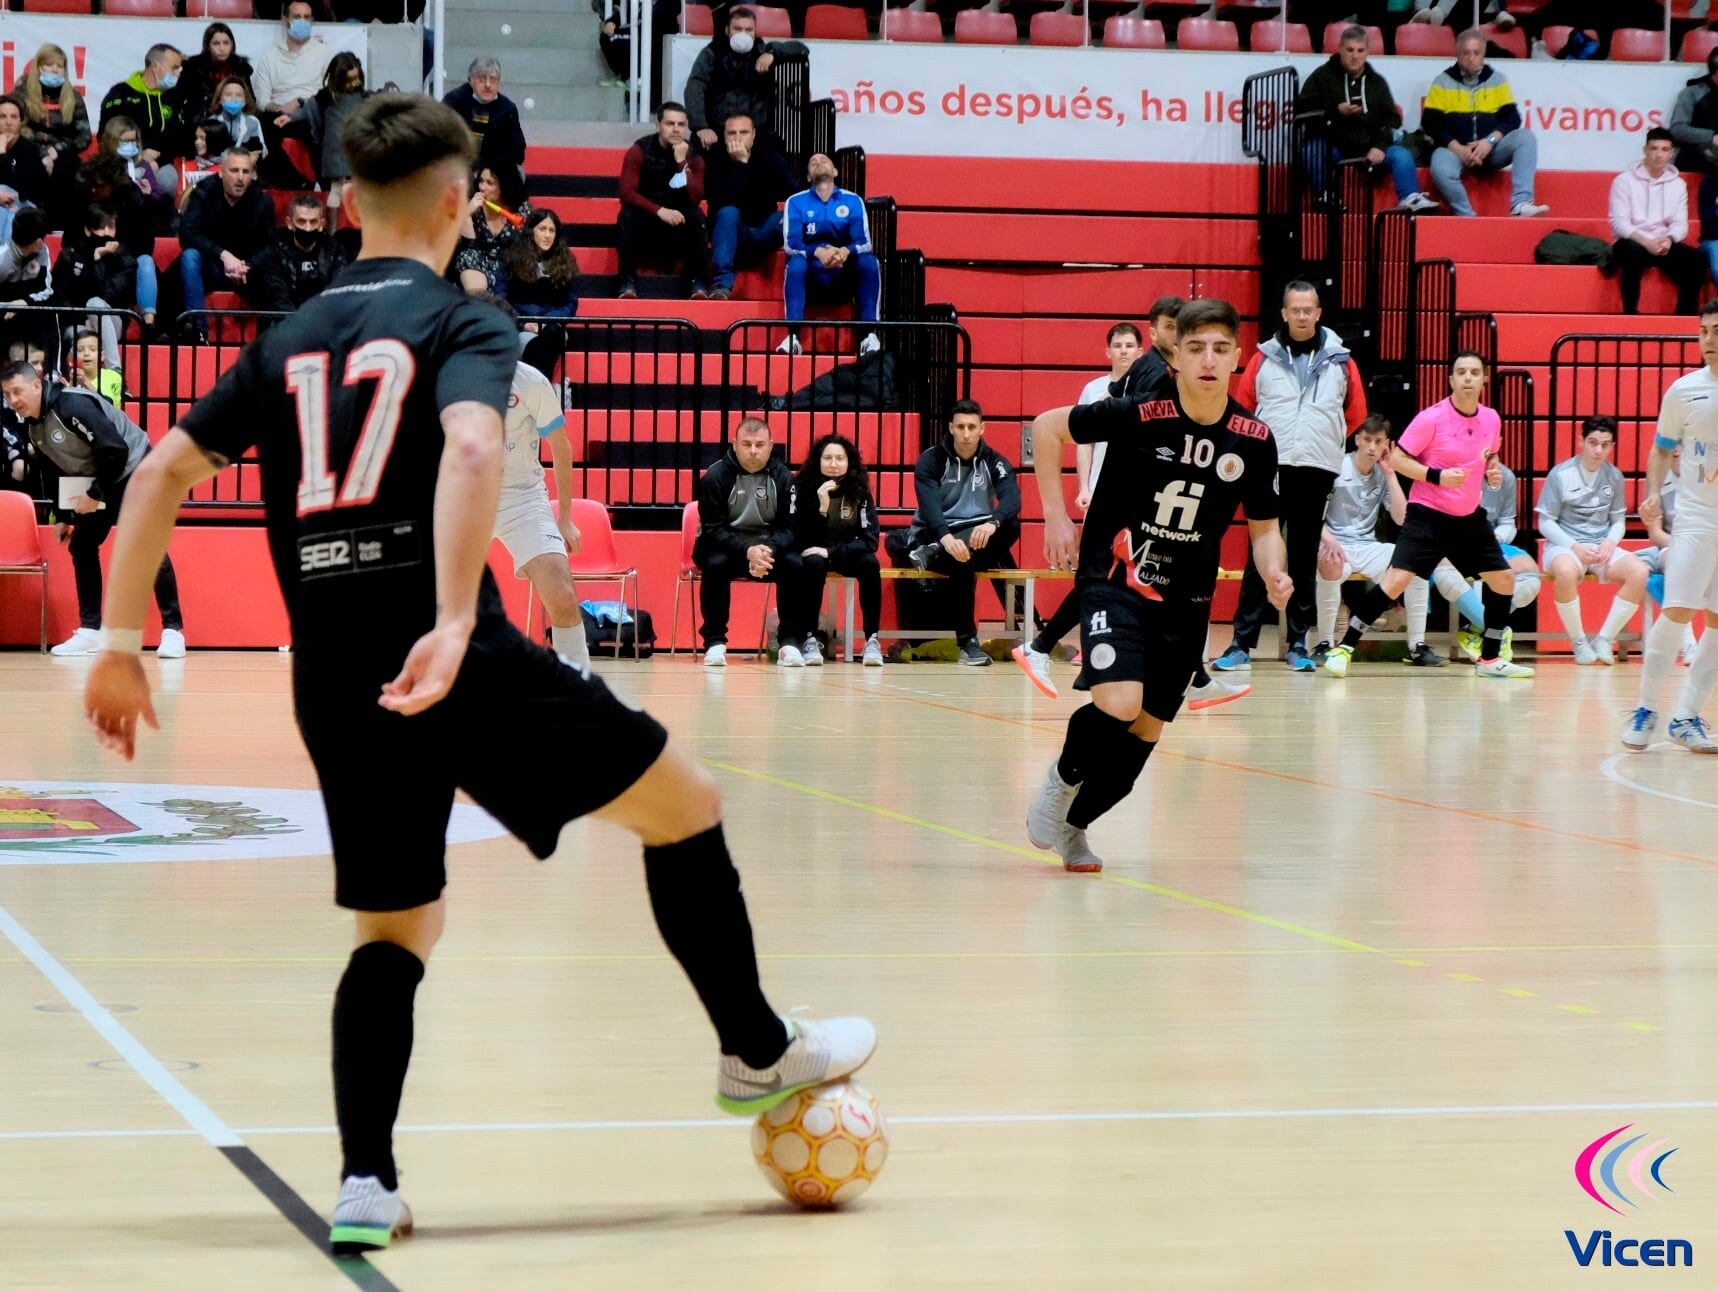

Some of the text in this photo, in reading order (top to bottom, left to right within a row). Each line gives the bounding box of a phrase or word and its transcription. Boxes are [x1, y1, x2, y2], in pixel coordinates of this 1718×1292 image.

[830, 80, 926, 115] años
[941, 84, 1125, 127] después,
[1141, 89, 1188, 122] ha
[284, 338, 417, 518] 17
[1231, 416, 1267, 438] ELDA
[1180, 434, 1215, 468] 10
[1154, 480, 1205, 531] fi
[1141, 521, 1202, 542] network
